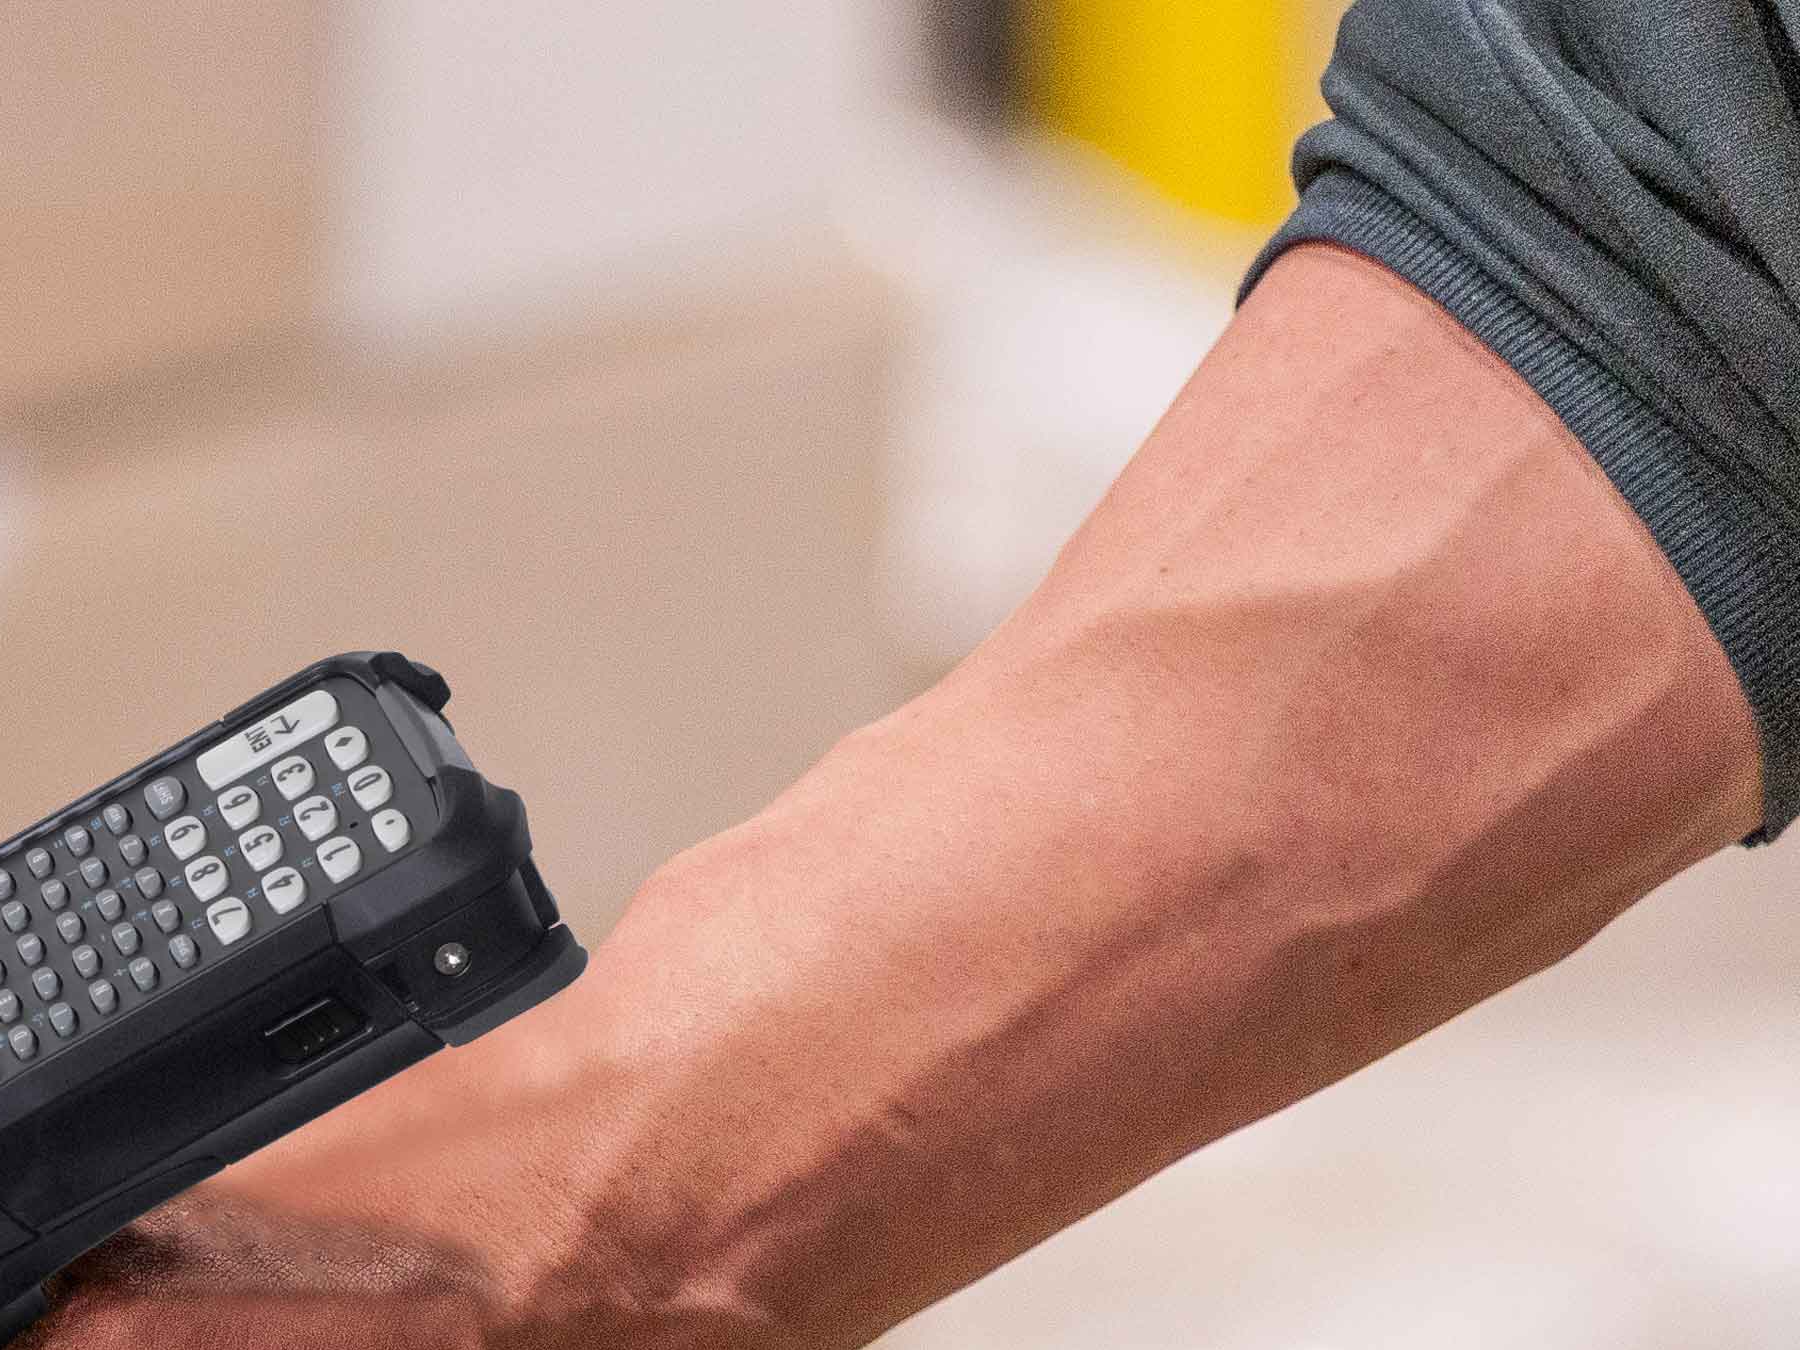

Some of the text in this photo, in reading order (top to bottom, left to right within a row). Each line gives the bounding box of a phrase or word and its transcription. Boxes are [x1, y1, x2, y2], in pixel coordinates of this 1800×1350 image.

[245, 726, 273, 753] ENT
[277, 763, 306, 782] 3
[353, 772, 382, 792] 0
[153, 782, 174, 805] SHIFT
[224, 793, 252, 810] 6
[300, 802, 329, 821] 2
[171, 824, 199, 841] 9
[246, 832, 274, 852] 5
[323, 844, 352, 862] 1
[191, 862, 221, 882] 8
[267, 874, 295, 891] 4
[211, 907, 242, 926] 7
